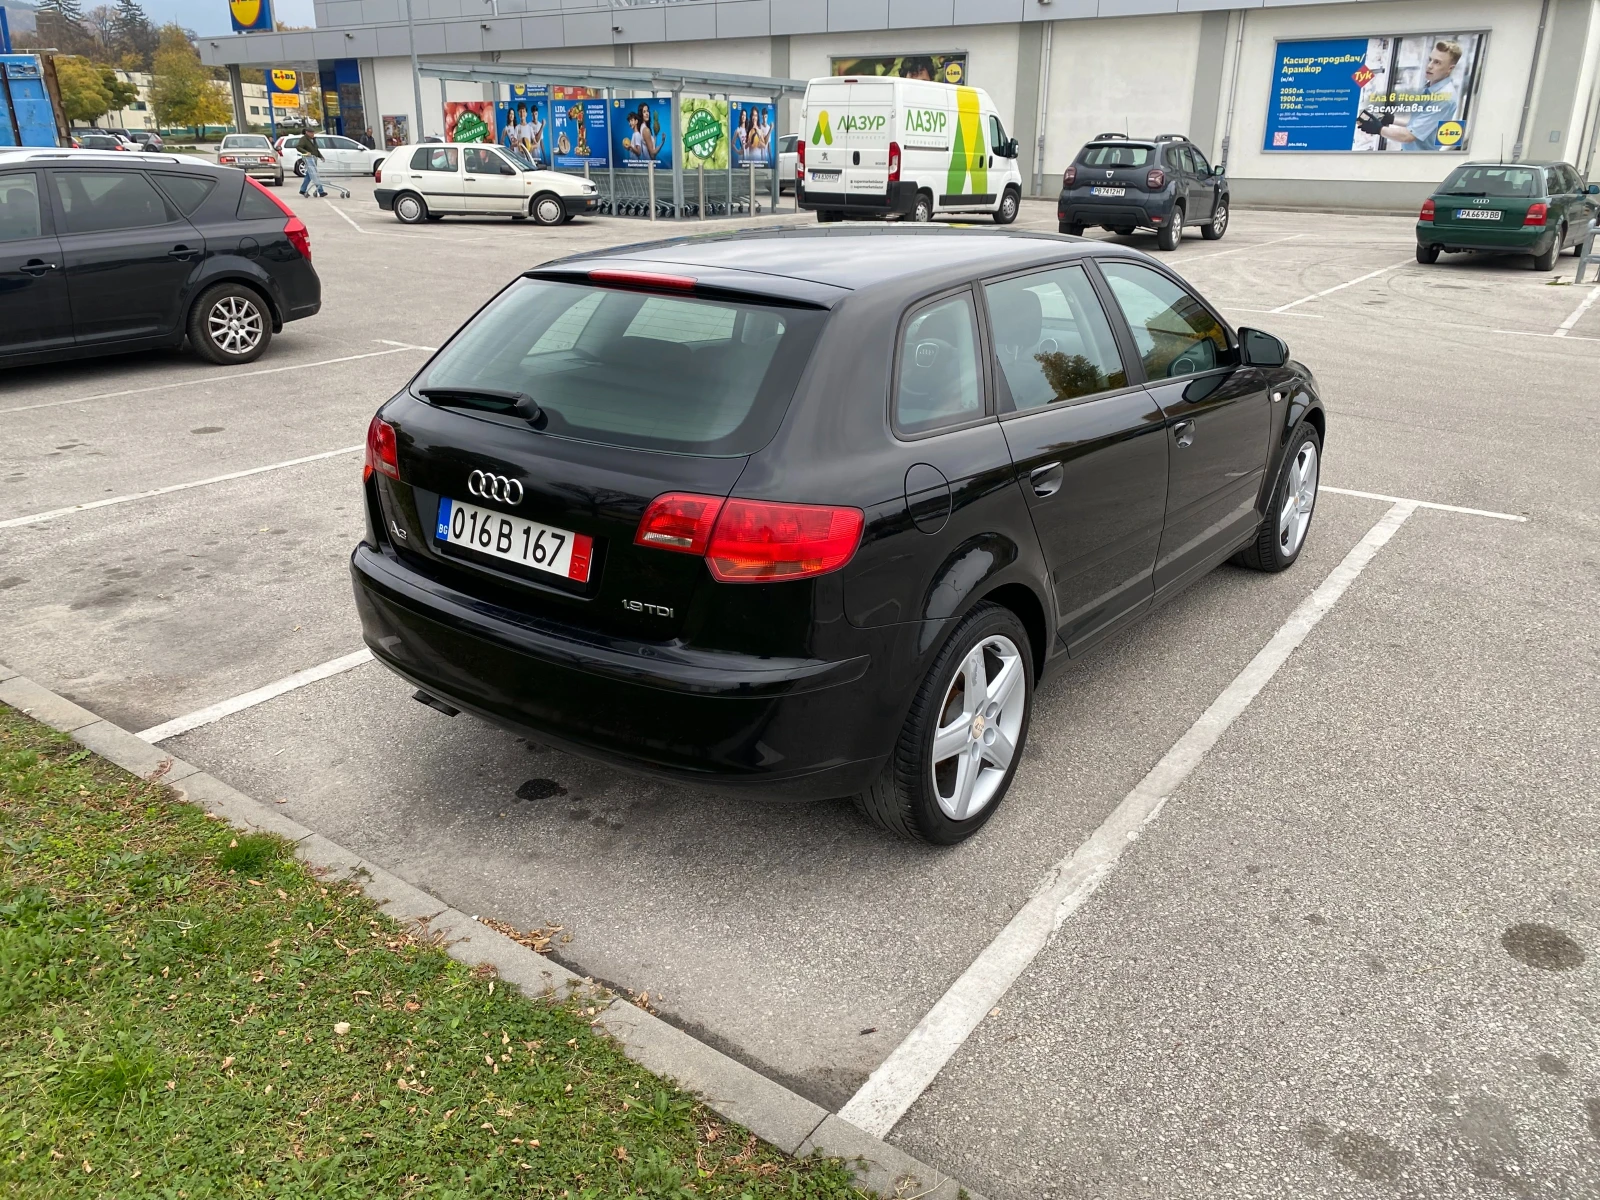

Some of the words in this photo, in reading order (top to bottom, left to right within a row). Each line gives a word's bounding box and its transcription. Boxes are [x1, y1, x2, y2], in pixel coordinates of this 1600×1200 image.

[1281, 65, 1322, 74] Аранжор
[1354, 70, 1372, 82] Тук
[1367, 103, 1423, 114] Заслужава
[837, 115, 886, 130] ЛАЗУР
[905, 109, 946, 133] ЛАЗУР
[688, 126, 717, 143] ПРОВЕРЕНИ
[438, 523, 449, 535] BG
[572, 562, 586, 575] 27
